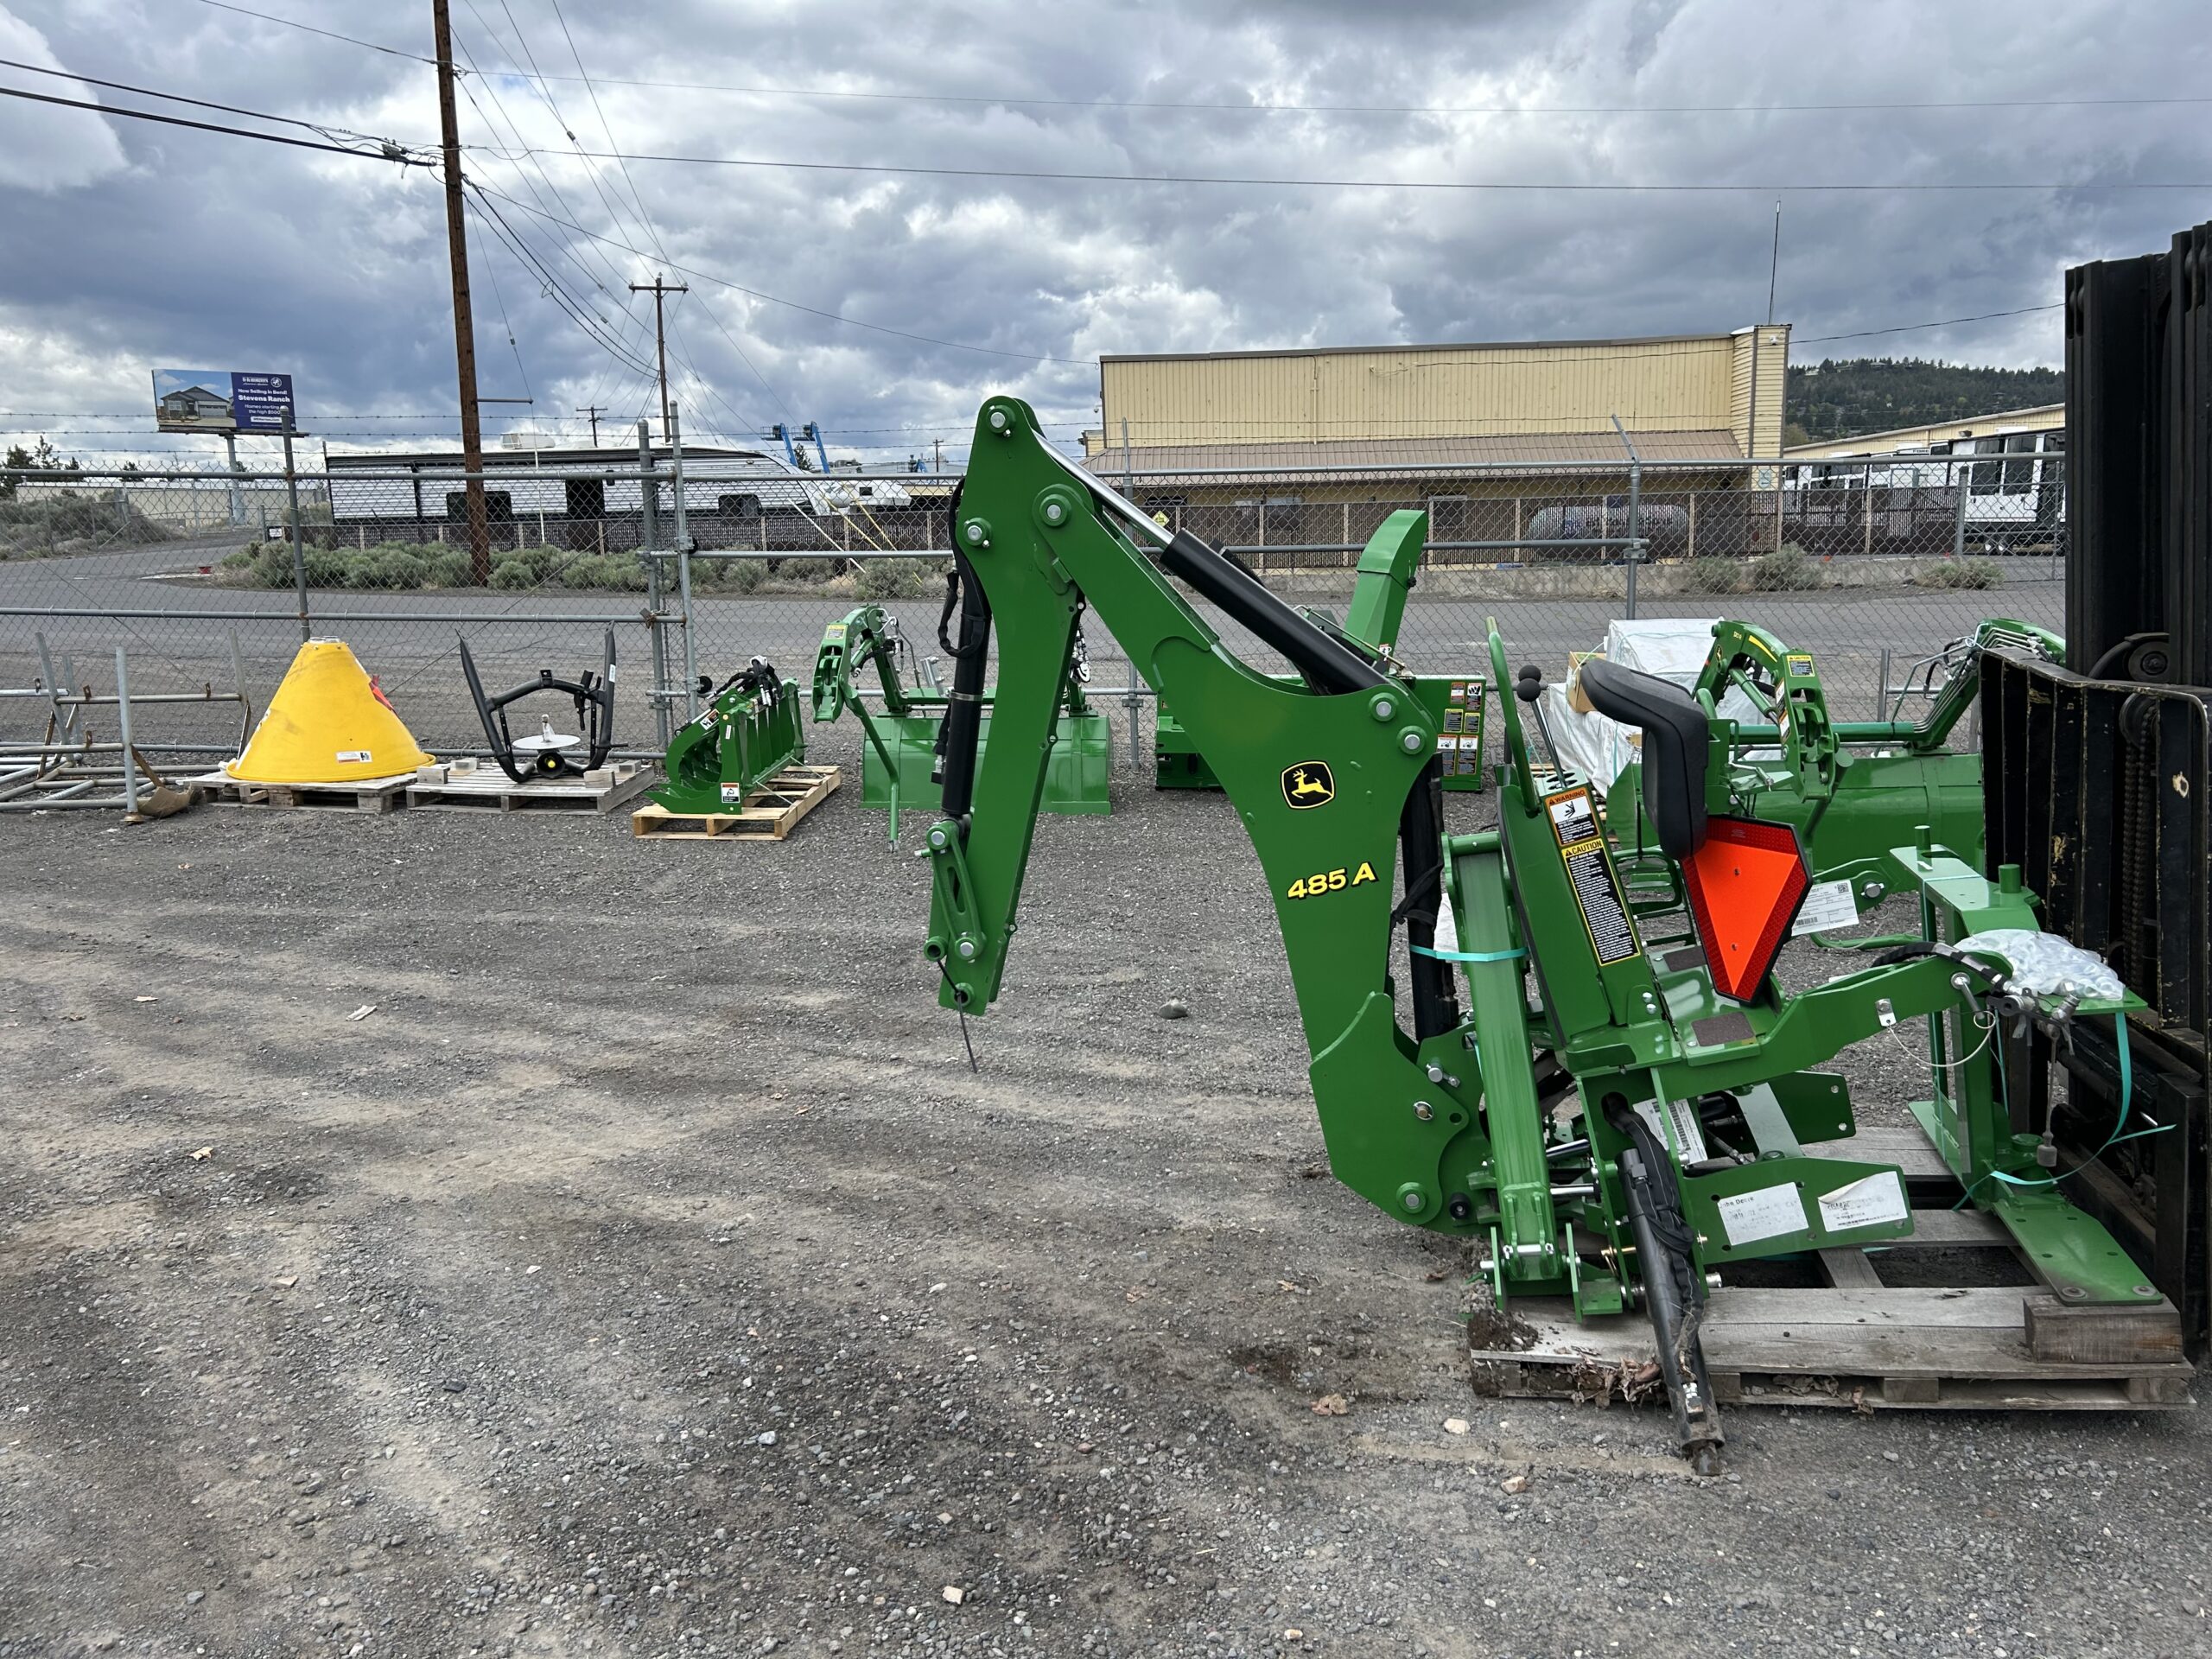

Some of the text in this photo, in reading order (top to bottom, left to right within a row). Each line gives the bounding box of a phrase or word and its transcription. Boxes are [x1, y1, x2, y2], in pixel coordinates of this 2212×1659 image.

[1554, 790, 1586, 803] WARNING
[1571, 840, 1603, 855] CAUTION
[1287, 861, 1379, 899] 485 A
